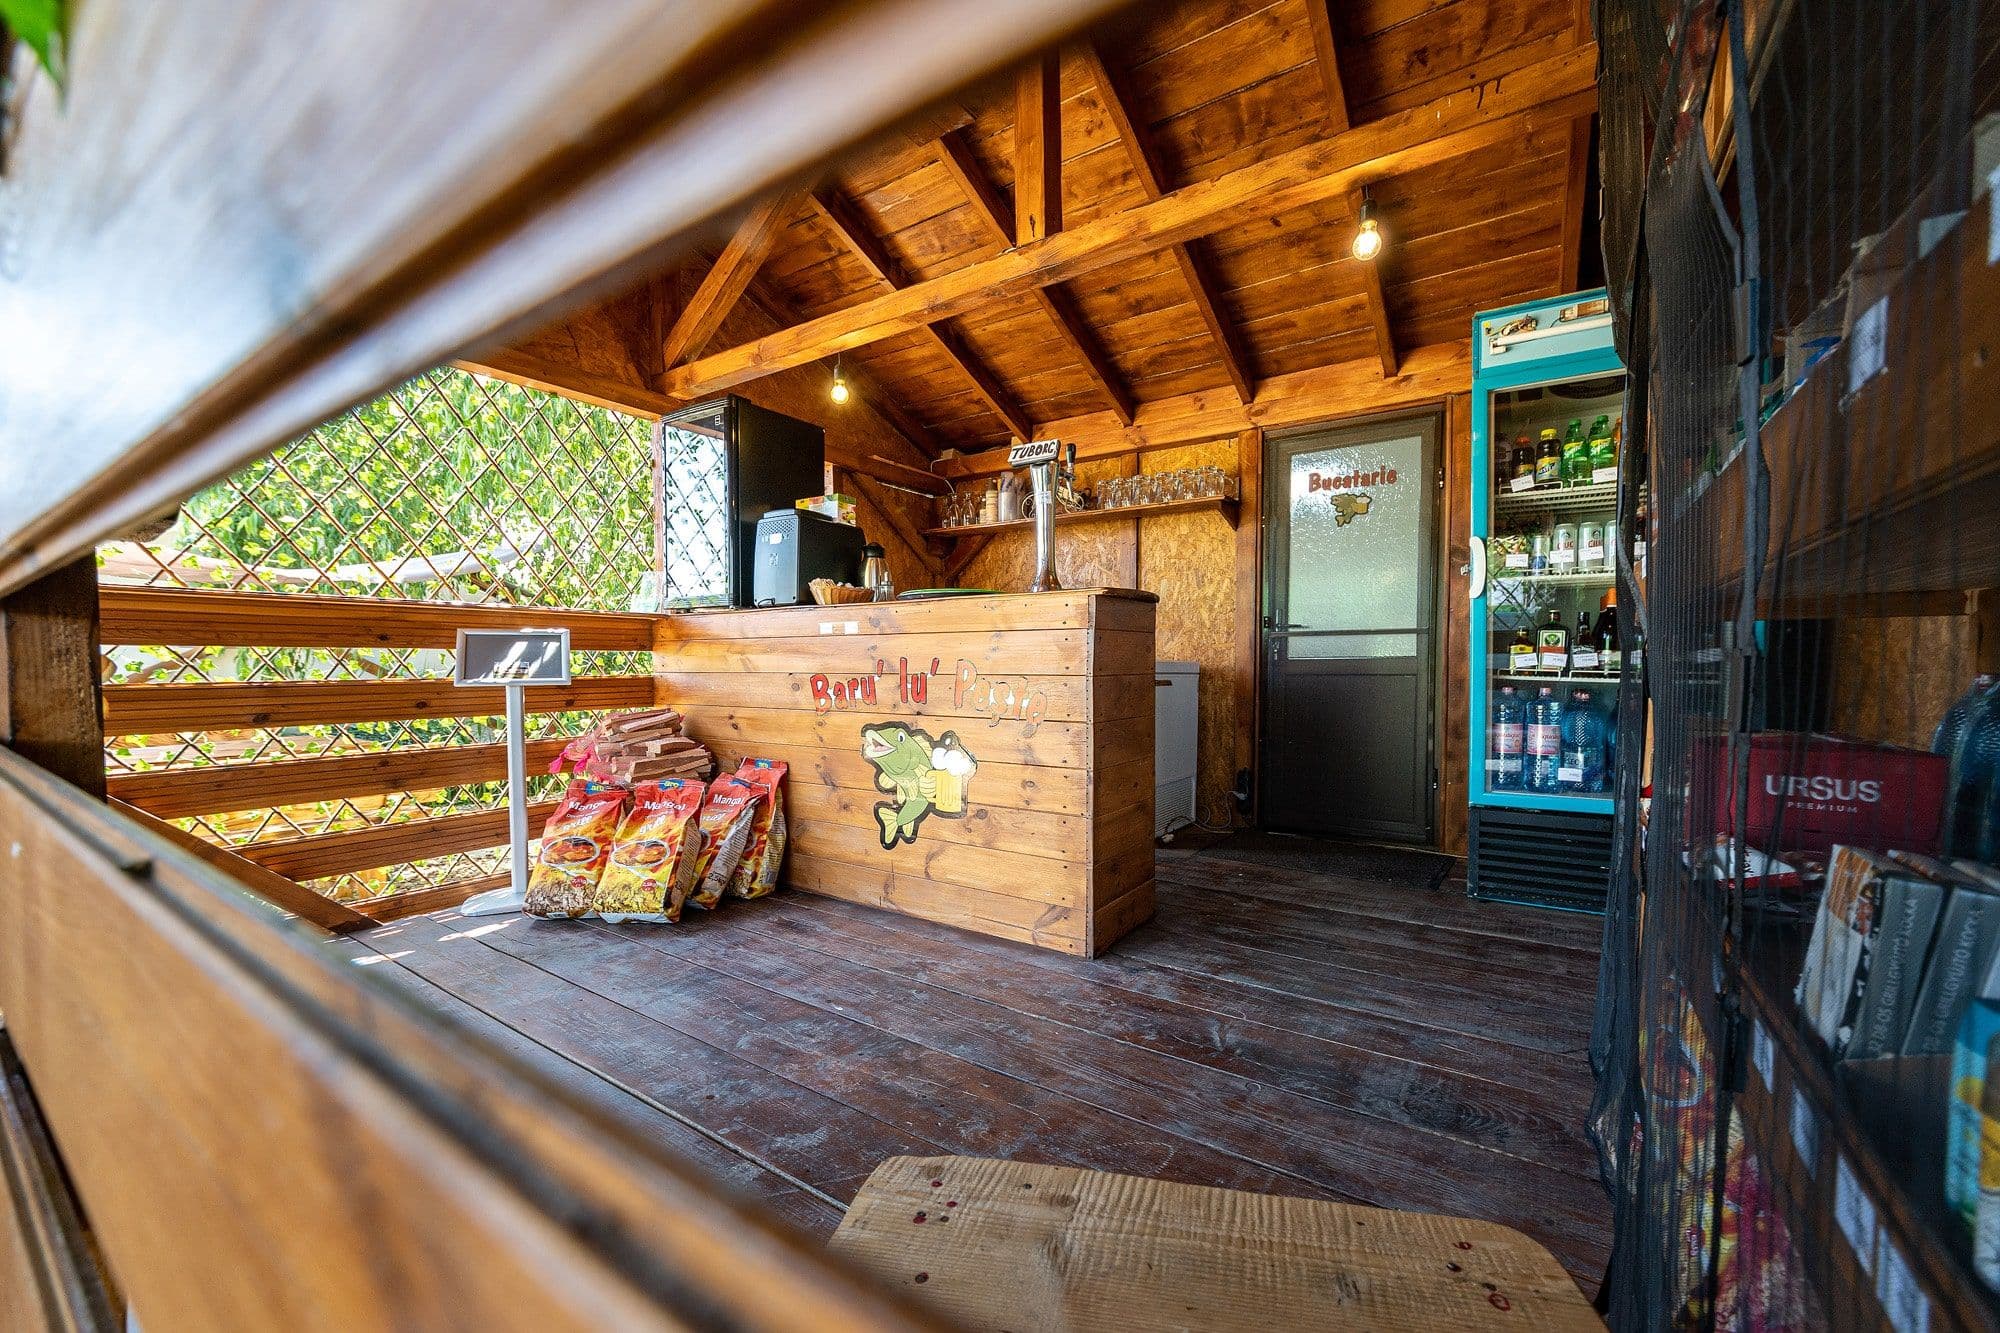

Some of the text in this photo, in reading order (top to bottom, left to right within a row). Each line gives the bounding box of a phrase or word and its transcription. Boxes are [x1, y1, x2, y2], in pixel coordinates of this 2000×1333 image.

[1012, 441, 1056, 460] TUBORG
[810, 659, 884, 716] Baru'
[900, 657, 939, 704] lu'
[1765, 774, 1882, 803] URSUS
[1787, 801, 1858, 814] PREMIUM
